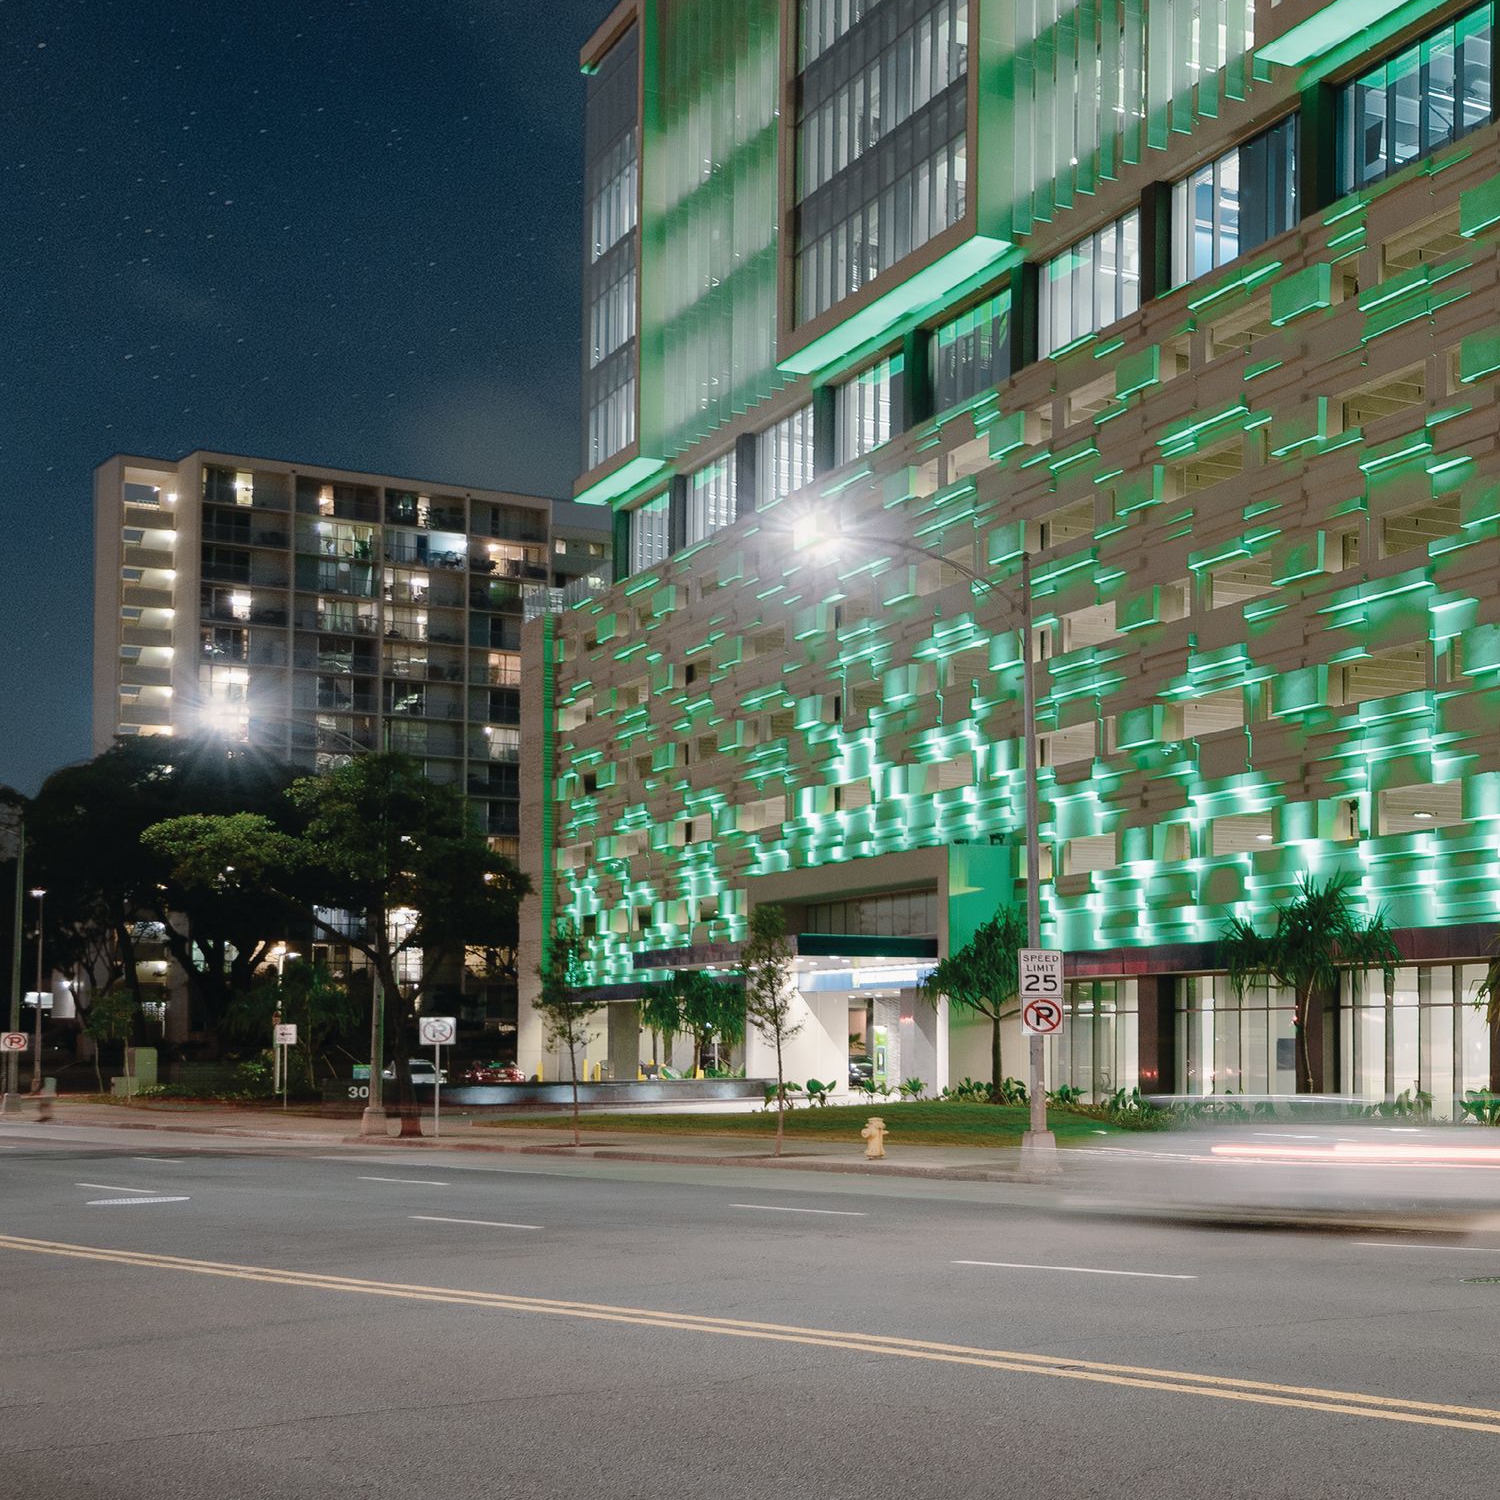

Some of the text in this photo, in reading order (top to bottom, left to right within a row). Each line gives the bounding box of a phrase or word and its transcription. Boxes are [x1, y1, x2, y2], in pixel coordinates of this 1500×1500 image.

[1022, 954, 1059, 963] SPEED
[1026, 964, 1055, 972] LIMIT
[1024, 974, 1058, 991] 25
